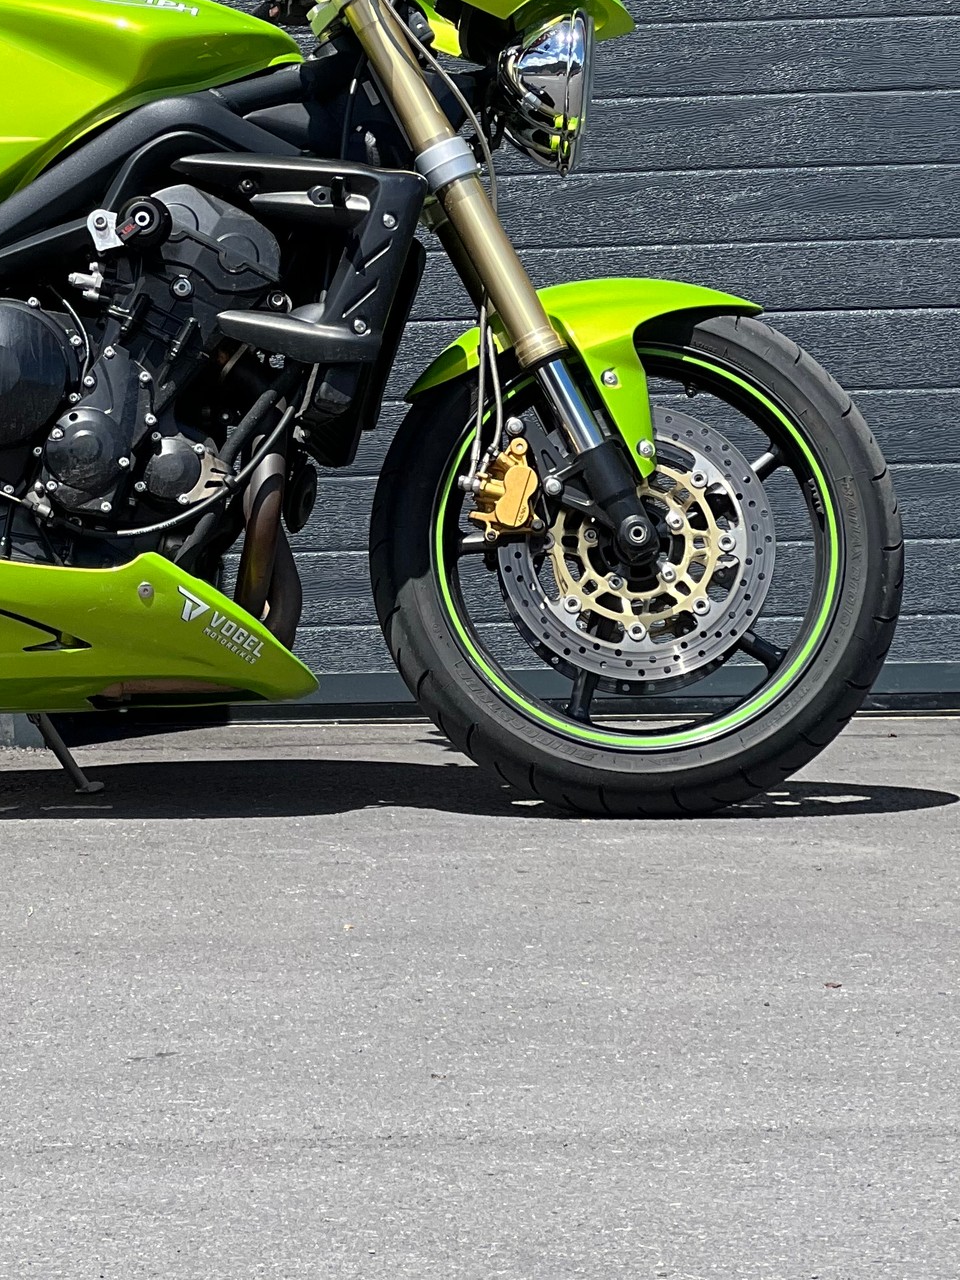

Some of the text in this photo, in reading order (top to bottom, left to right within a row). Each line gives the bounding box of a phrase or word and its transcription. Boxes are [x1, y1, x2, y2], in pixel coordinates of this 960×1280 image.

[202, 627, 257, 665] MOTORBIKES
[209, 610, 265, 658] VOGEL
[454, 665, 596, 762] BRIDGESTONE
